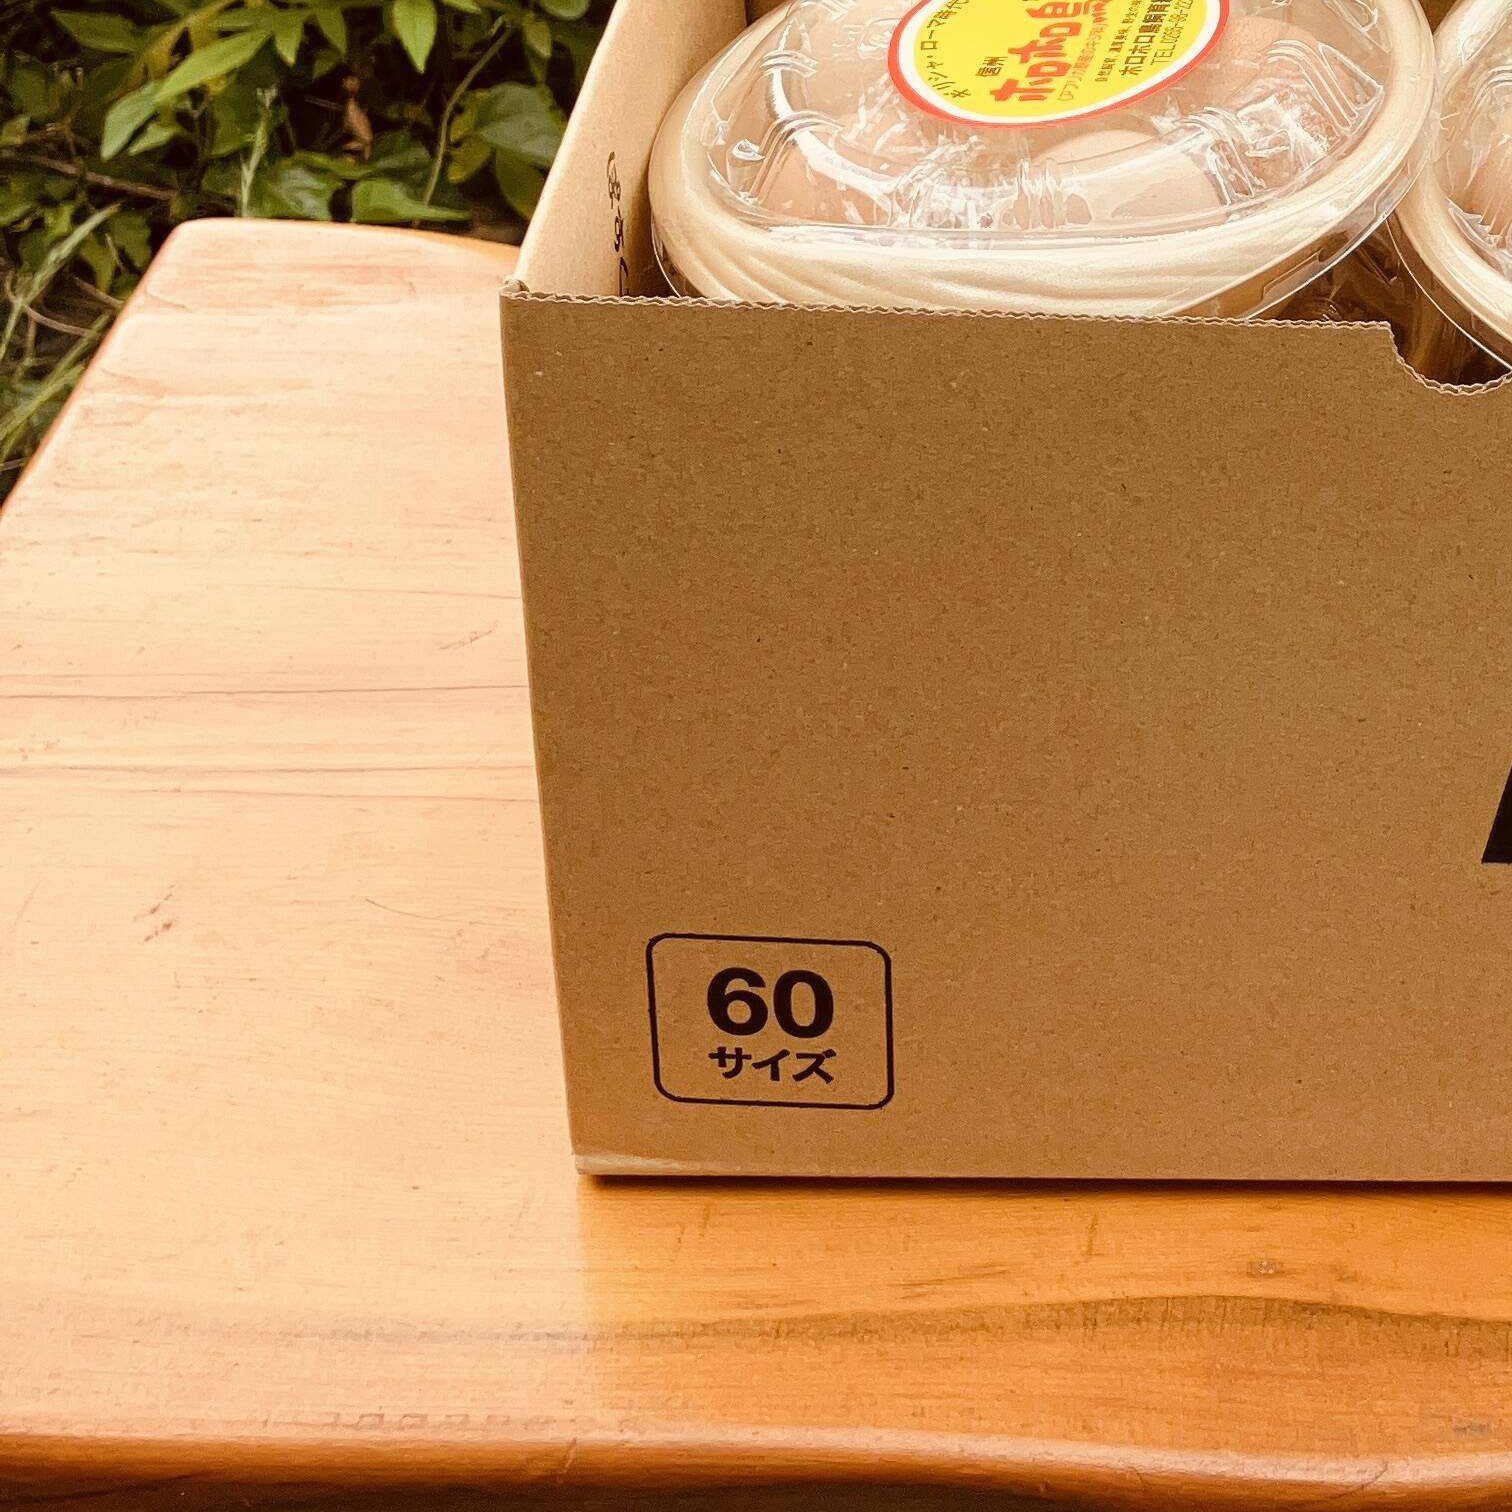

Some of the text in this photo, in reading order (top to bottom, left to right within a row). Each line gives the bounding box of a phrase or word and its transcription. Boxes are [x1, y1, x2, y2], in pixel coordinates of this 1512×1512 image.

[706, 967, 834, 1039] 60
[708, 1046, 837, 1084] サイズ
